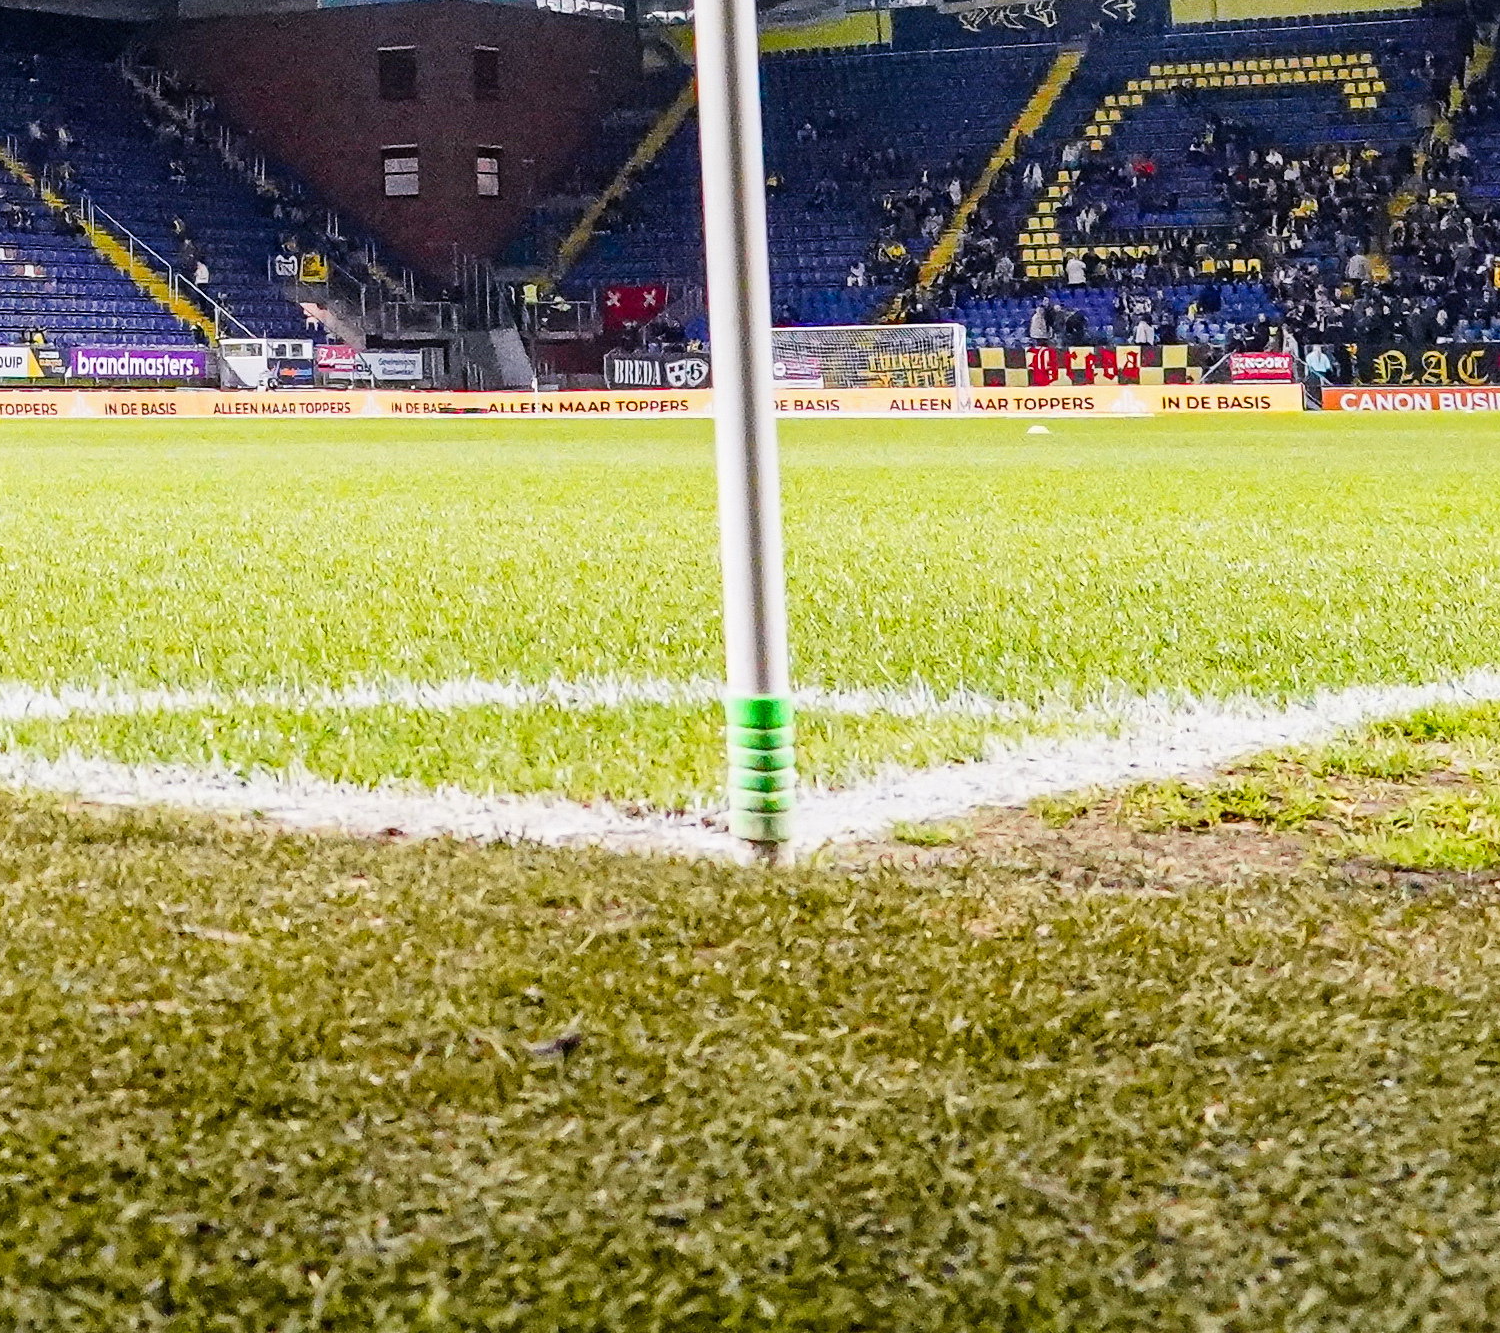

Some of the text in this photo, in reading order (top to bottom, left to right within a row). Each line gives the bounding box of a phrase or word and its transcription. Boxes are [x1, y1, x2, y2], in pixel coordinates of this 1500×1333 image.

[613, 358, 662, 385] BREDA
[213, 401, 351, 415] ALLEEN MAAR TOPPERS
[390, 401, 421, 414] IN DE
[488, 399, 689, 414] ALLEEN MAAR TOPPERS
[794, 399, 840, 412] BASIS
[889, 398, 952, 412] ALLEEN
[1013, 397, 1095, 410] TOPPERS
[1162, 396, 1271, 410] IN DE BASIS
[1339, 391, 1438, 412] CANON
[104, 402, 177, 416] IN DE BASIS
